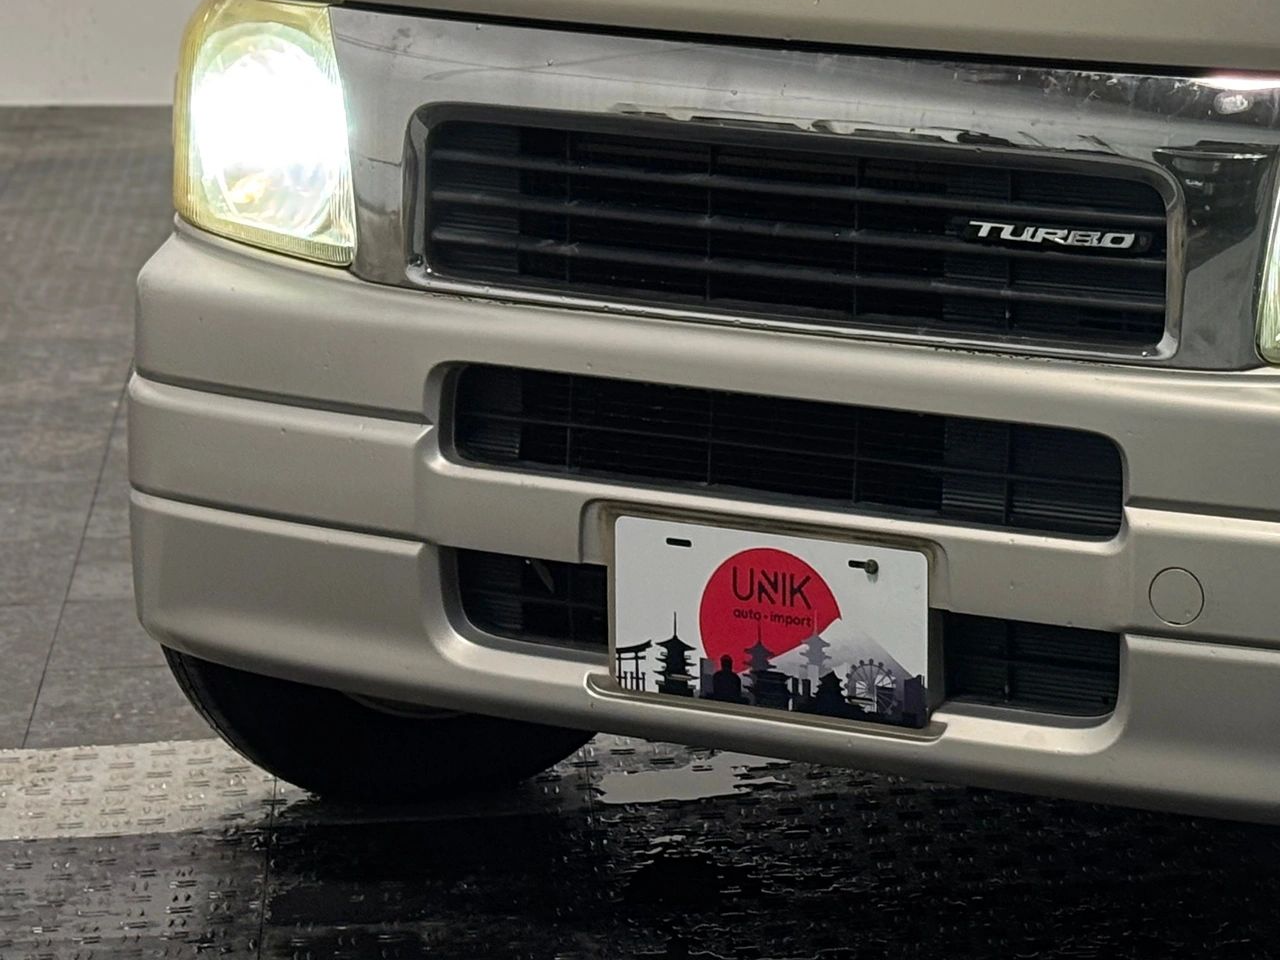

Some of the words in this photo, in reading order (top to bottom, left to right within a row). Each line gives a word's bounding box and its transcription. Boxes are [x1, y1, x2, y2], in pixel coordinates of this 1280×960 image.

[968, 220, 1135, 249] TURBO
[732, 566, 812, 610] UNIK
[733, 608, 762, 622] auto
[770, 611, 812, 628] import
